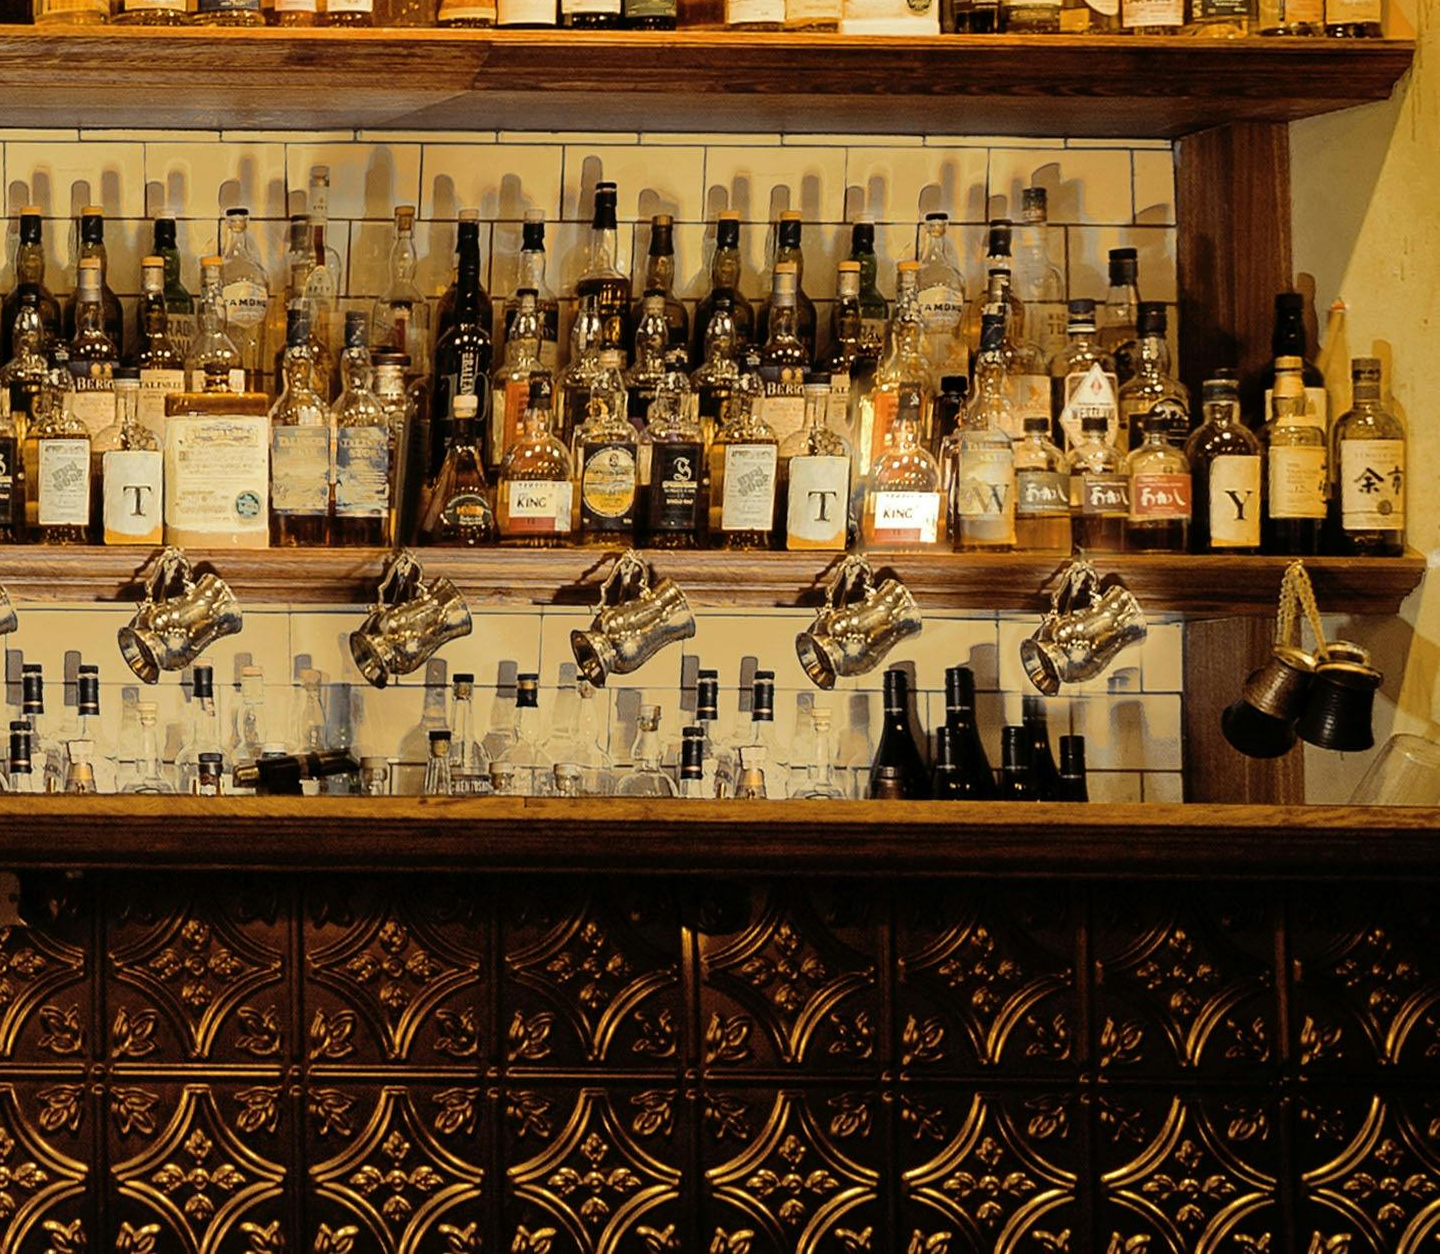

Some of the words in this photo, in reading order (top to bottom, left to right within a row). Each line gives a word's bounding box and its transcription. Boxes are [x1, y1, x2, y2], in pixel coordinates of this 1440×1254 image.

[122, 483, 151, 518] T
[516, 495, 547, 508] KING
[807, 491, 838, 522] T
[882, 507, 914, 520] KING
[966, 483, 1009, 514] W
[1224, 489, 1255, 521] Y
